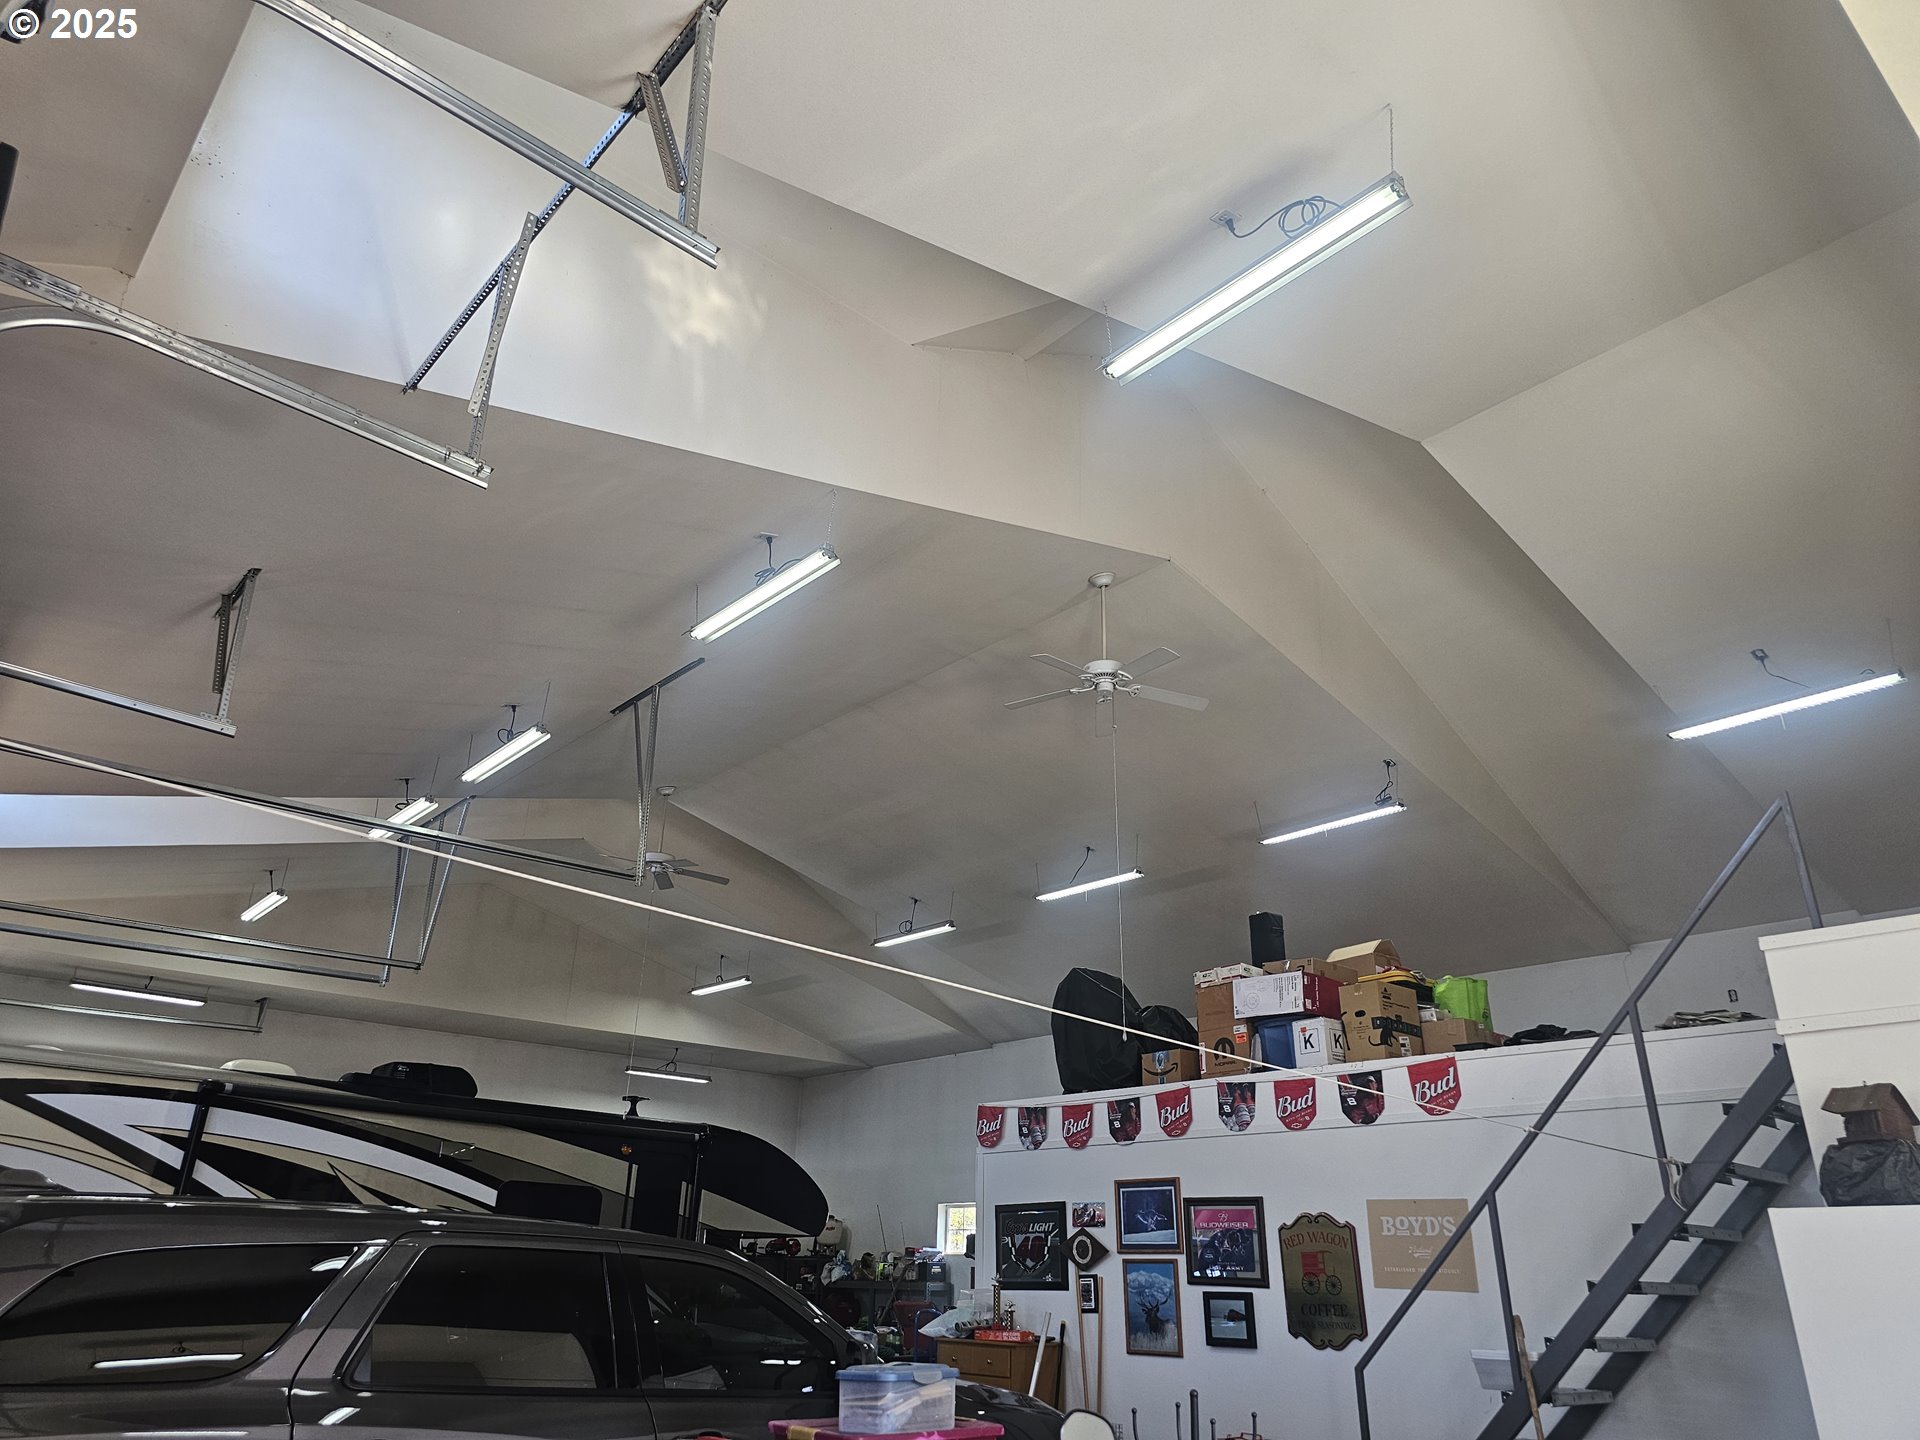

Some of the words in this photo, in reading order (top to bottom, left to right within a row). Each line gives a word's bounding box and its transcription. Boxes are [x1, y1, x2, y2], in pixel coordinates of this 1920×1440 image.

[1303, 1033, 1315, 1050] K
[1333, 1033, 1343, 1050] K
[1414, 1066, 1456, 1104] Bud
[1222, 1104, 1232, 1113] 8
[1277, 1086, 1314, 1118] Bud
[1346, 1096, 1357, 1106] 8
[1160, 1094, 1190, 1128] Bud
[977, 1114, 1001, 1136] Bud
[1021, 1126, 1028, 1134] 8
[1063, 1111, 1090, 1137] Bud
[1113, 1120, 1121, 1128] 8
[1029, 1222, 1055, 1232] LIGHT
[1380, 1215, 1457, 1236] BOYD'S
[1283, 1233, 1304, 1250] RED
[1307, 1231, 1349, 1250] WAGON
[1301, 1303, 1348, 1317] COFFEE
